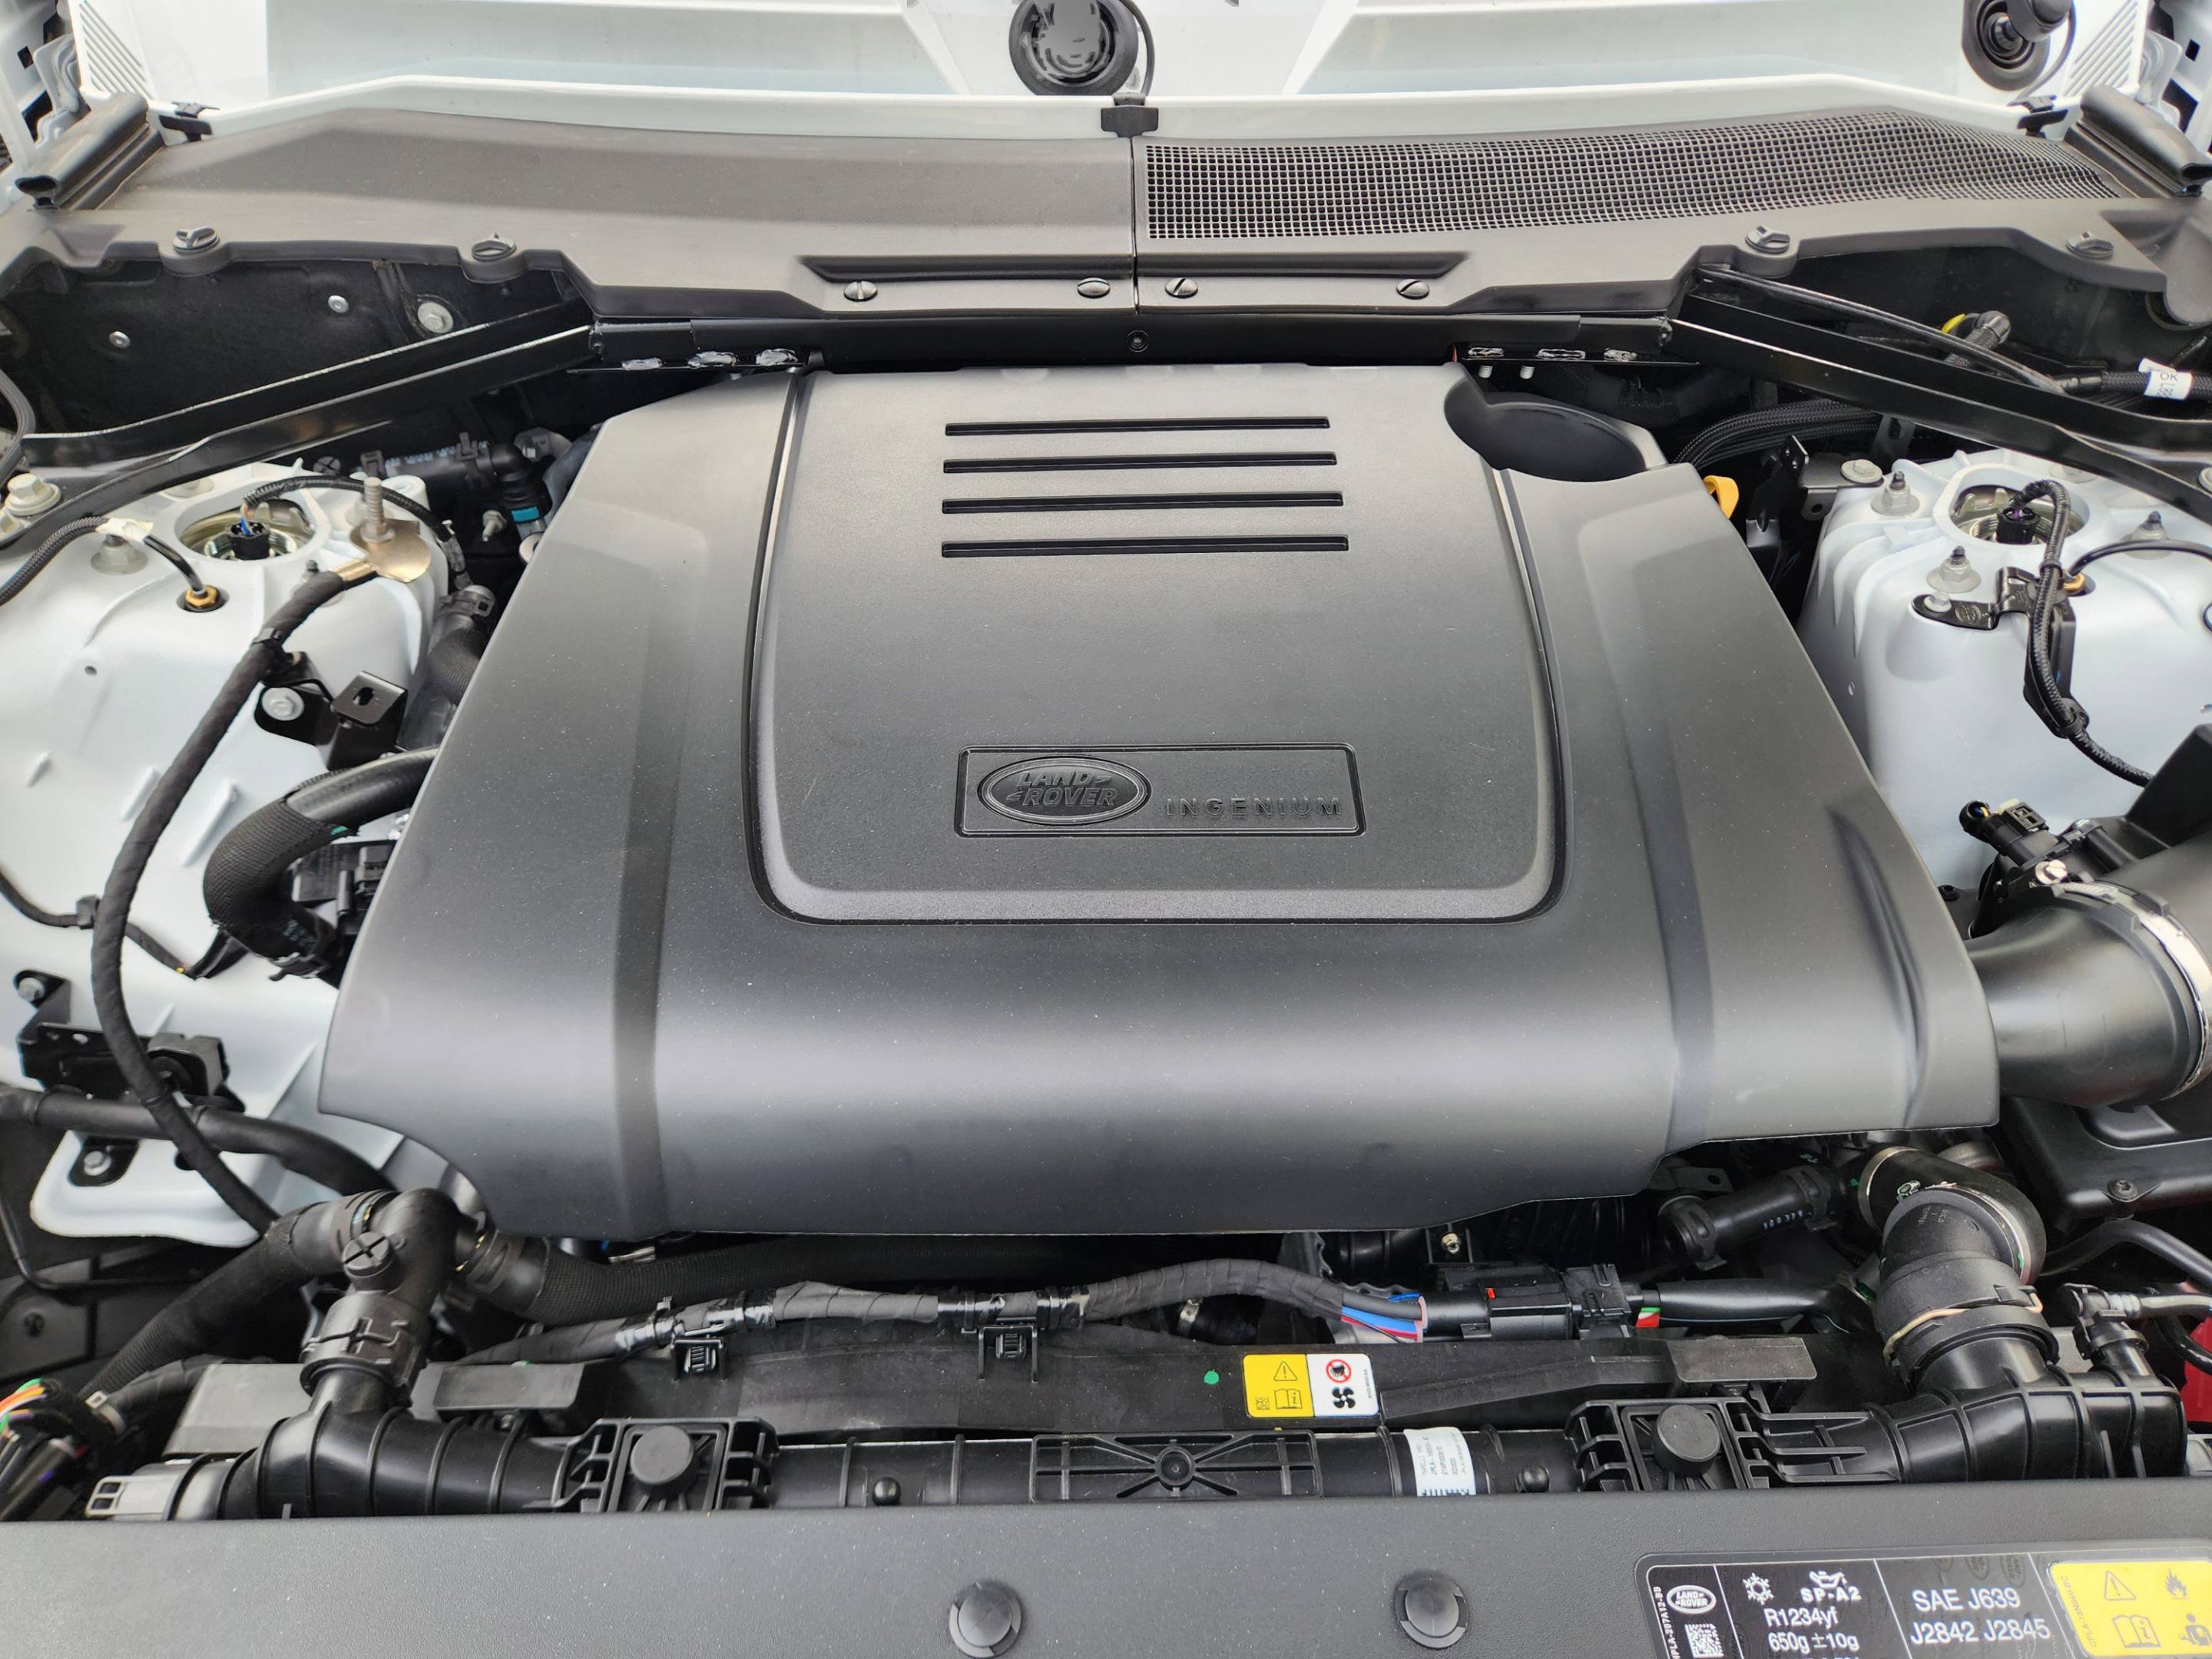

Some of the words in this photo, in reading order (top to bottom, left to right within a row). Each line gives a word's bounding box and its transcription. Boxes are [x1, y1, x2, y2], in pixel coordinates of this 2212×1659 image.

[2160, 373, 2178, 382] OK
[1016, 770, 1094, 786] LAND
[1022, 787, 1118, 806] ROVER
[1166, 796, 1341, 816] INGENIUM
[1680, 1598, 1709, 1608] ROVER
[1800, 1586, 1862, 1603] SP-A2
[1912, 1588, 1965, 1612] SAE
[1968, 1587, 2021, 1610] J639
[1763, 1605, 1839, 1630] R1234yf
[1909, 1621, 1980, 1646] J2842
[1983, 1618, 2051, 1642] J2845
[1768, 1631, 1810, 1655] 650g
